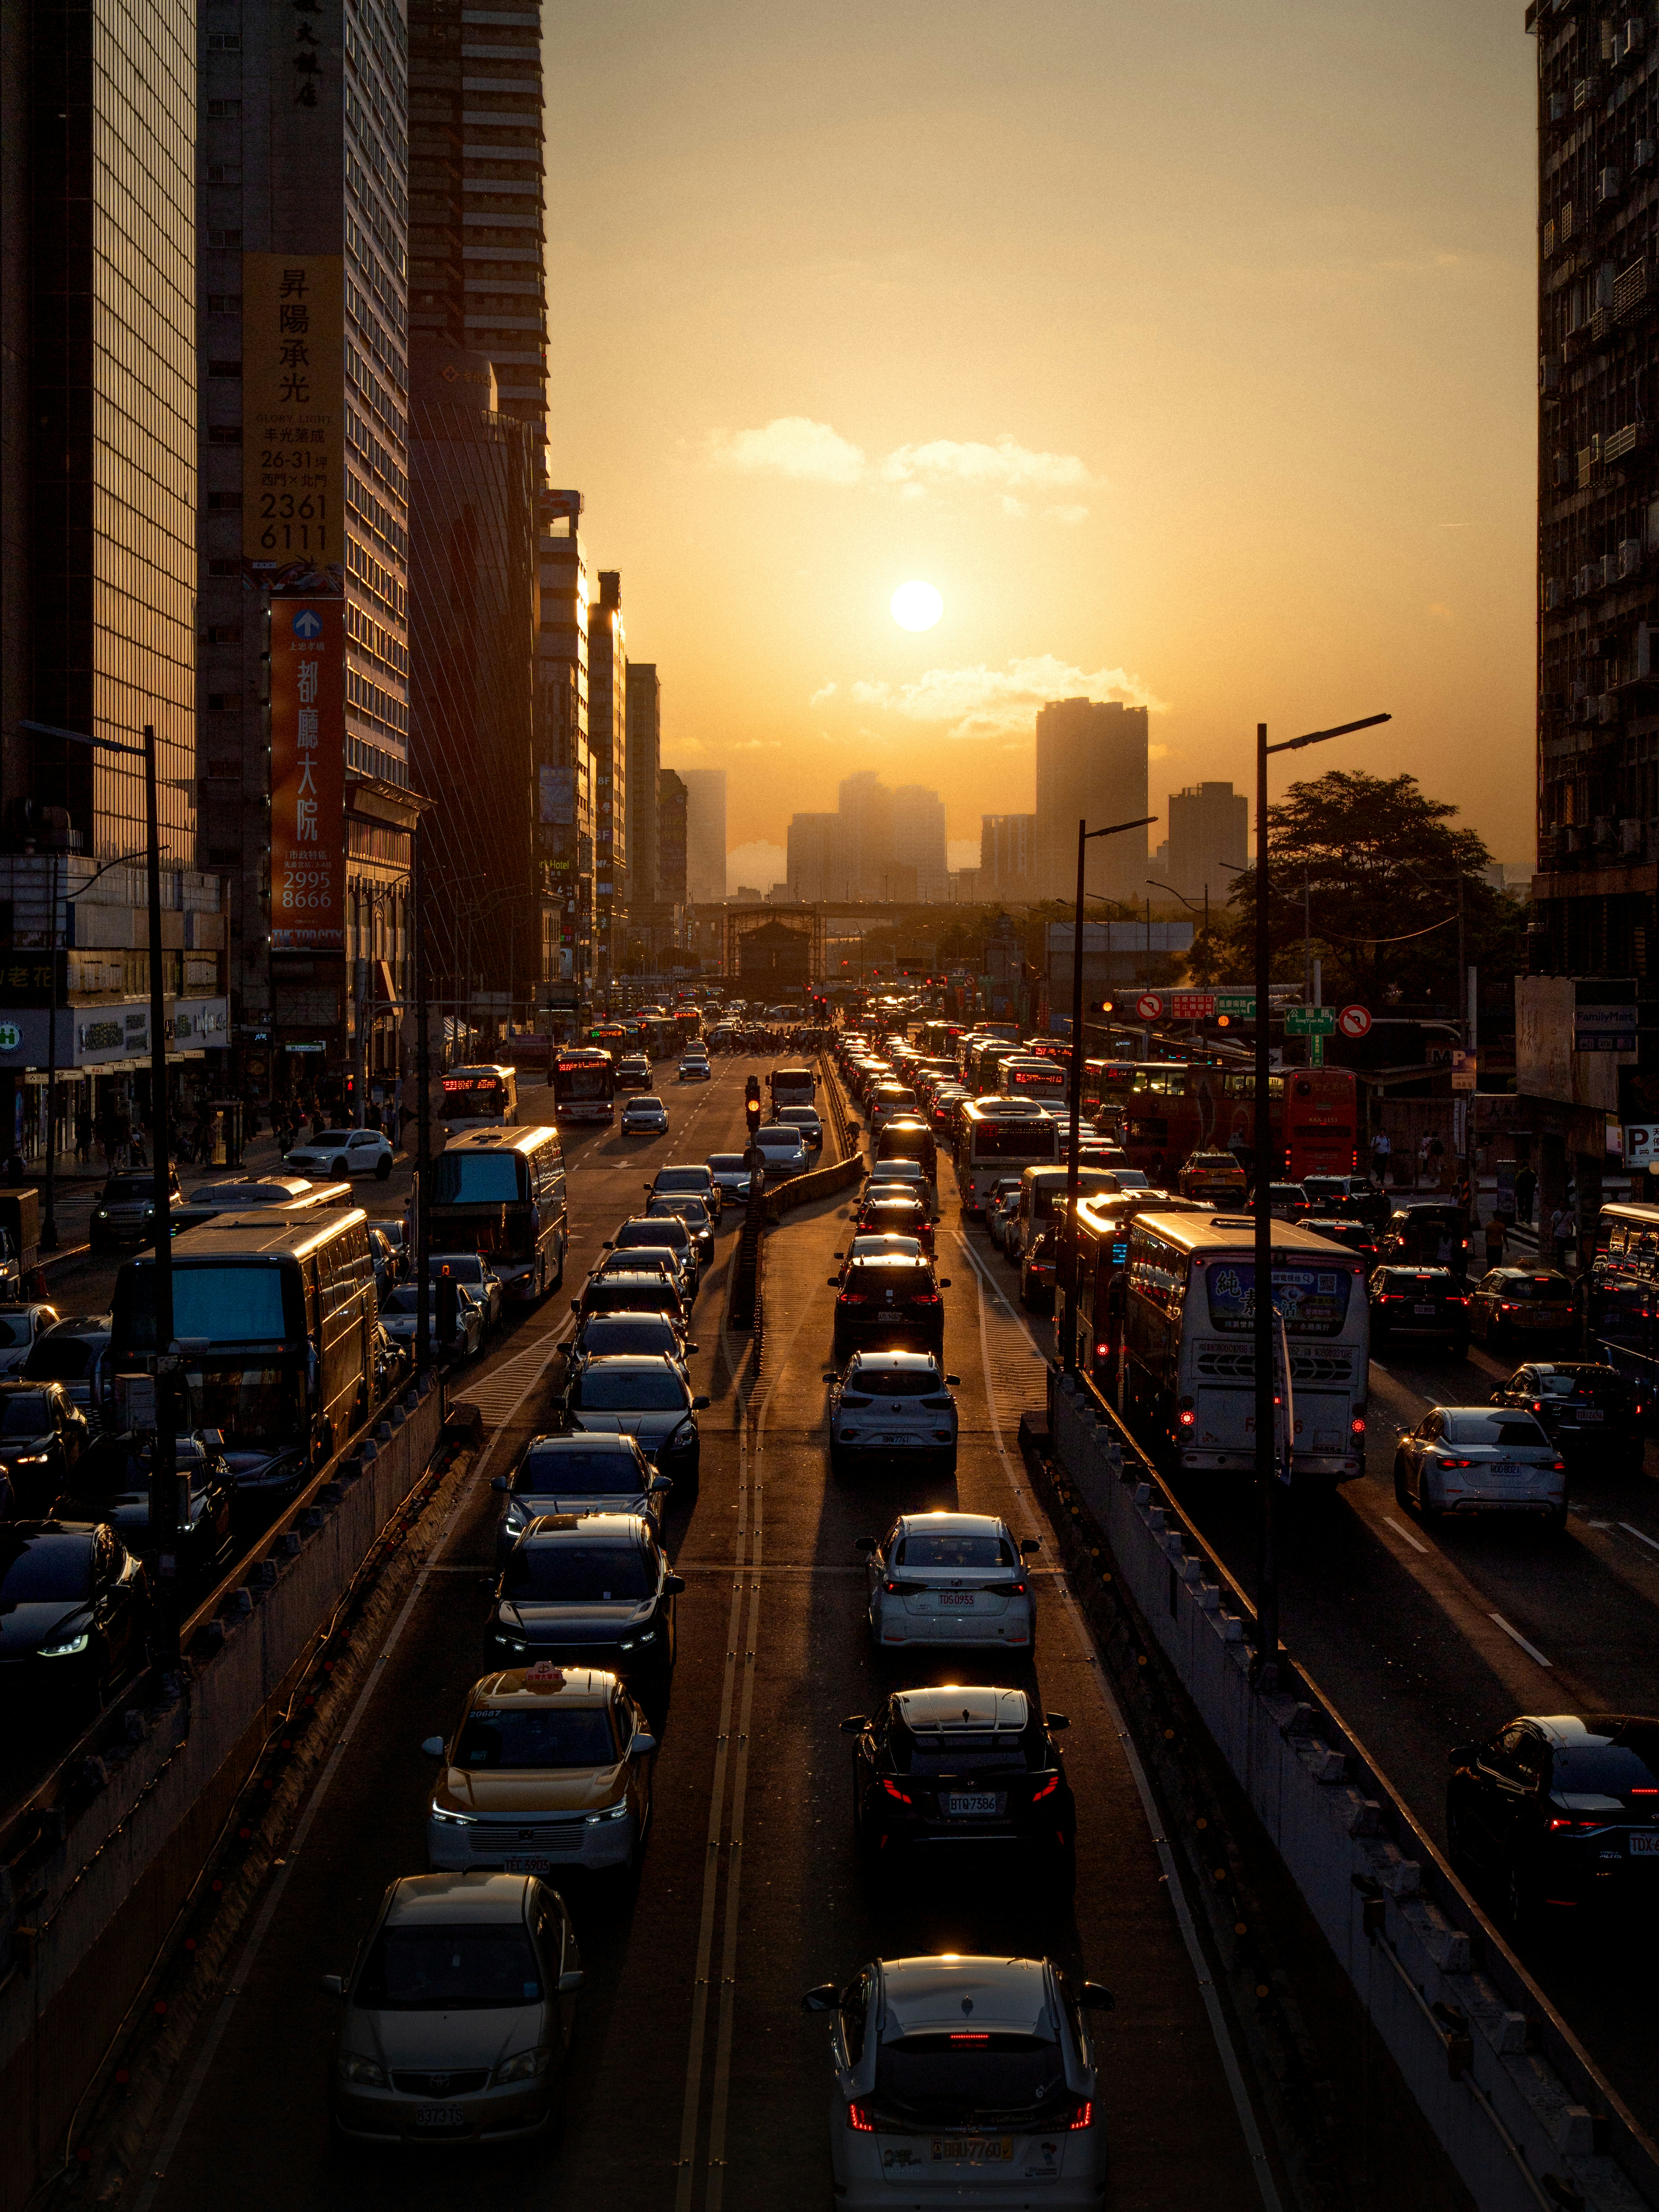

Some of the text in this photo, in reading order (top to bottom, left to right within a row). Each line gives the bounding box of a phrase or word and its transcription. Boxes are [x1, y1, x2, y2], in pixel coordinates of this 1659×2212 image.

[279, 269, 310, 403] 昇陽承光
[256, 414, 332, 424] GLORY LIGHT
[260, 493, 326, 519] 2361
[261, 524, 326, 550] 6111
[297, 660, 319, 841] 都廳大院
[598, 777, 610, 785] 8F
[550, 860, 569, 869] Hotel
[283, 871, 331, 889] 2995
[282, 891, 332, 908] 8666
[272, 929, 343, 947] THE TOP CITY
[0, 966, 51, 987] 老花
[1290, 1009, 1330, 1018] 公園路
[1577, 1011, 1634, 1023] FamilyMart
[1453, 1050, 1466, 1066] P
[1629, 1128, 1649, 1155] P
[528, 1672, 559, 1681] 台灣大車隊
[469, 1709, 501, 1719] 20687
[950, 1797, 995, 1810] BTQ-7386
